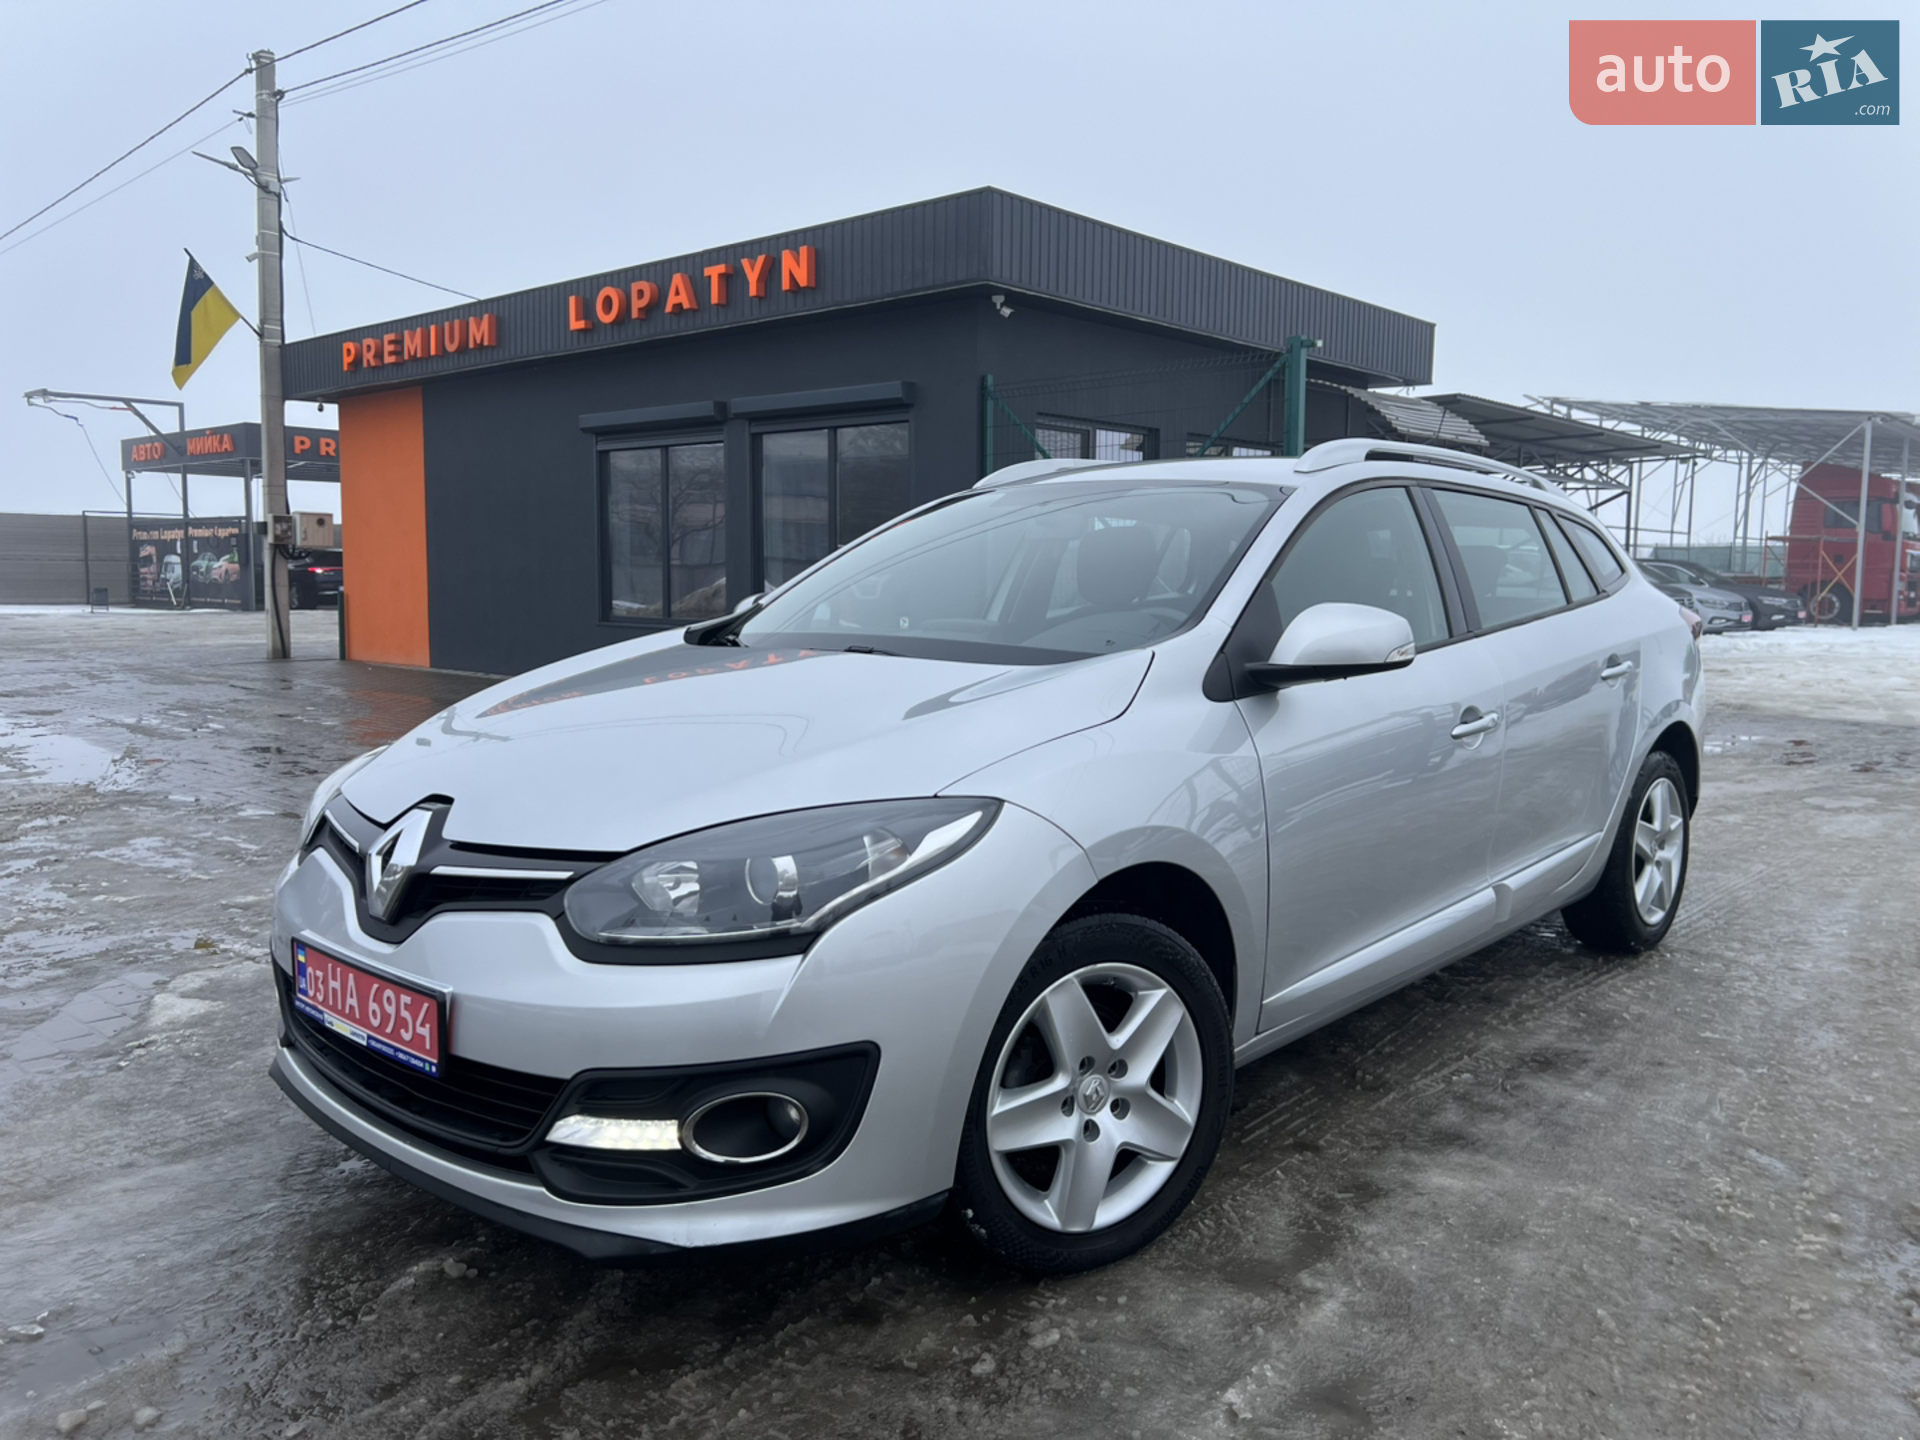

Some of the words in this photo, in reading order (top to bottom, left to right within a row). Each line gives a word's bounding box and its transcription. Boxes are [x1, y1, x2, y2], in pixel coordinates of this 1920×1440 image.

[342, 312, 498, 372] PREMIUM
[568, 244, 816, 332] LOPATYN
[131, 441, 165, 462] АВТО
[186, 429, 236, 457] МИЙКА
[368, 983, 431, 1051] 6954
